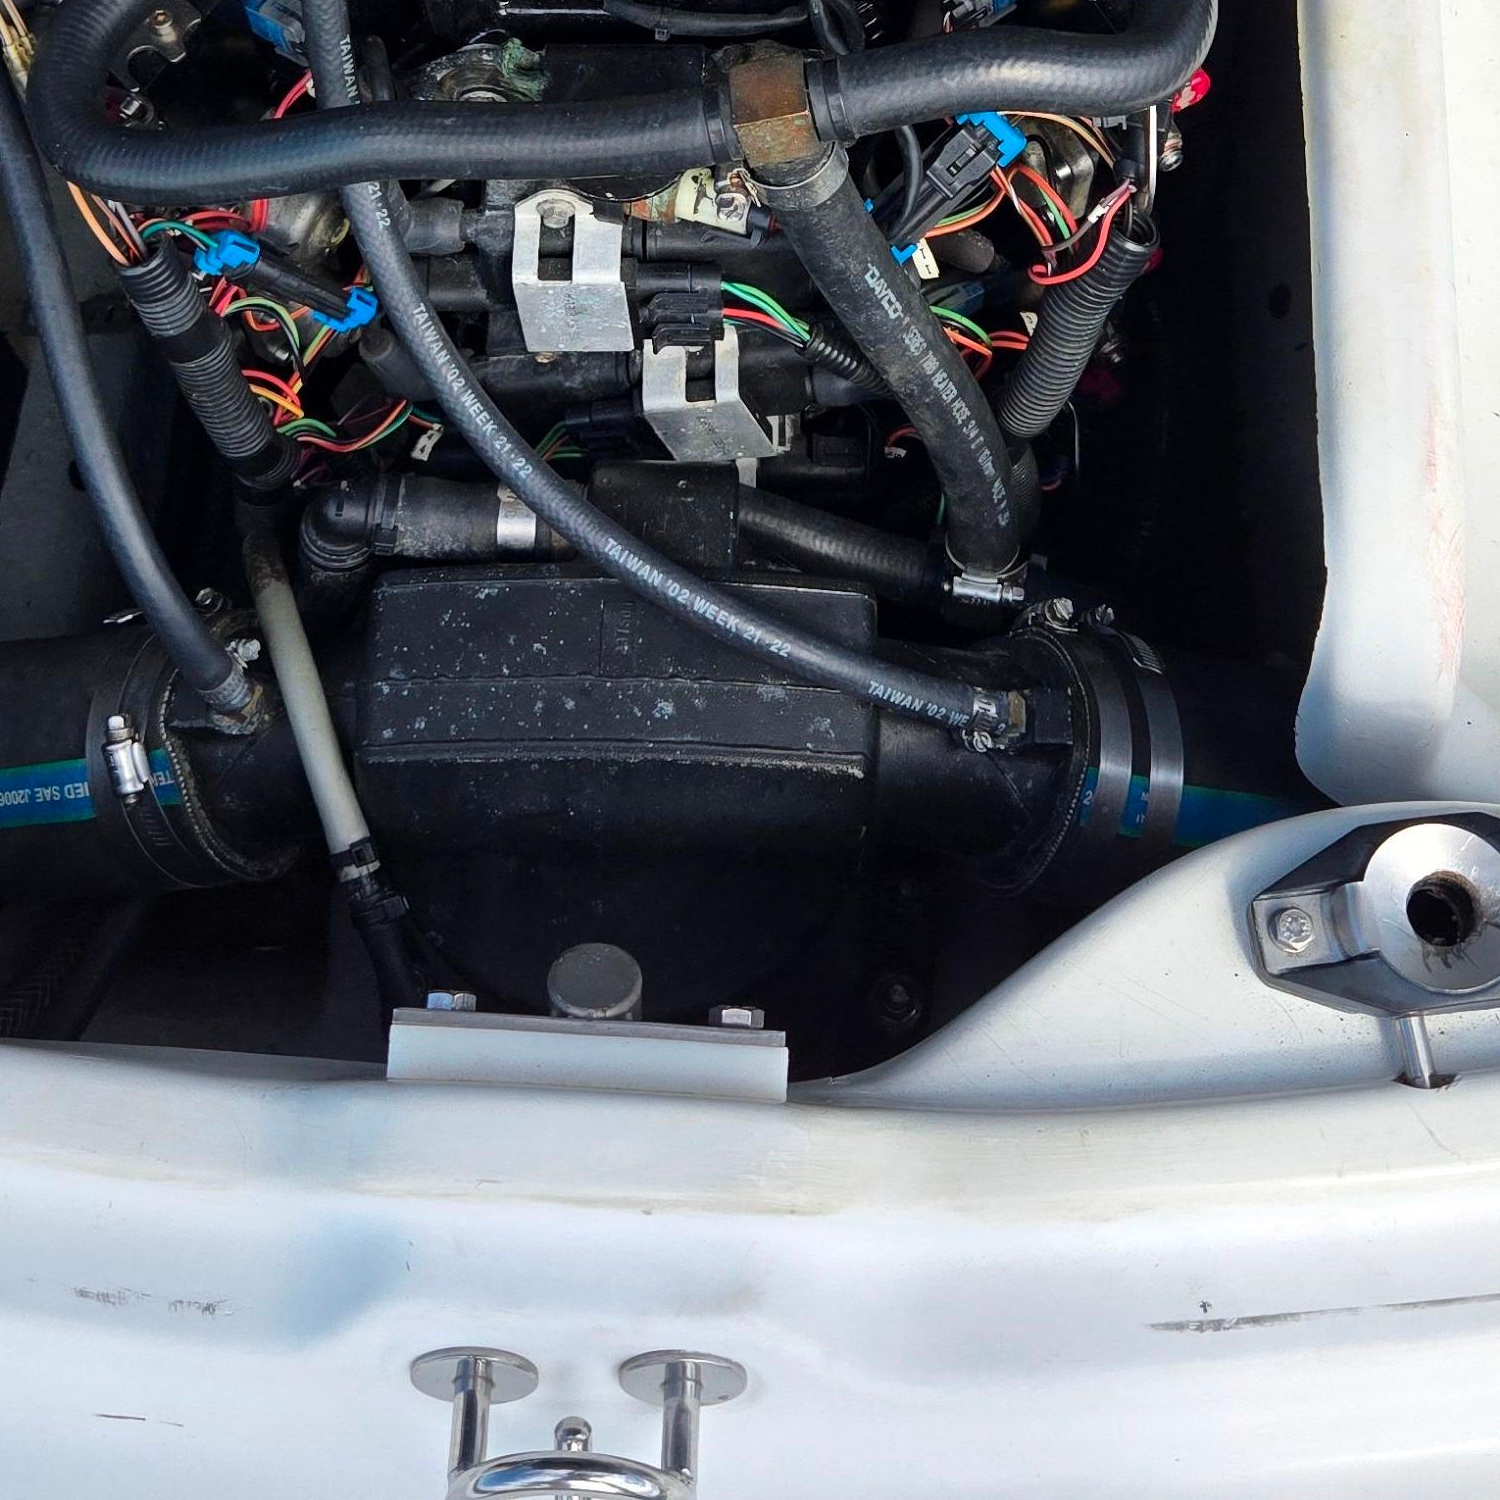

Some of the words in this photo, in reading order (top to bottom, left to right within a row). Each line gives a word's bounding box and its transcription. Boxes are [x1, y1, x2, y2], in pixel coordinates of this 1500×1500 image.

[414, 303, 451, 366] TAIWAN
[443, 363, 464, 391] '02
[462, 391, 496, 436] WEEK
[605, 538, 663, 587] TAIWAN
[664, 581, 691, 604] '02
[694, 596, 739, 632] WEEK
[869, 682, 924, 711] TAIWAN
[949, 712, 969, 728] WE
[34, 785, 60, 802] SAE
